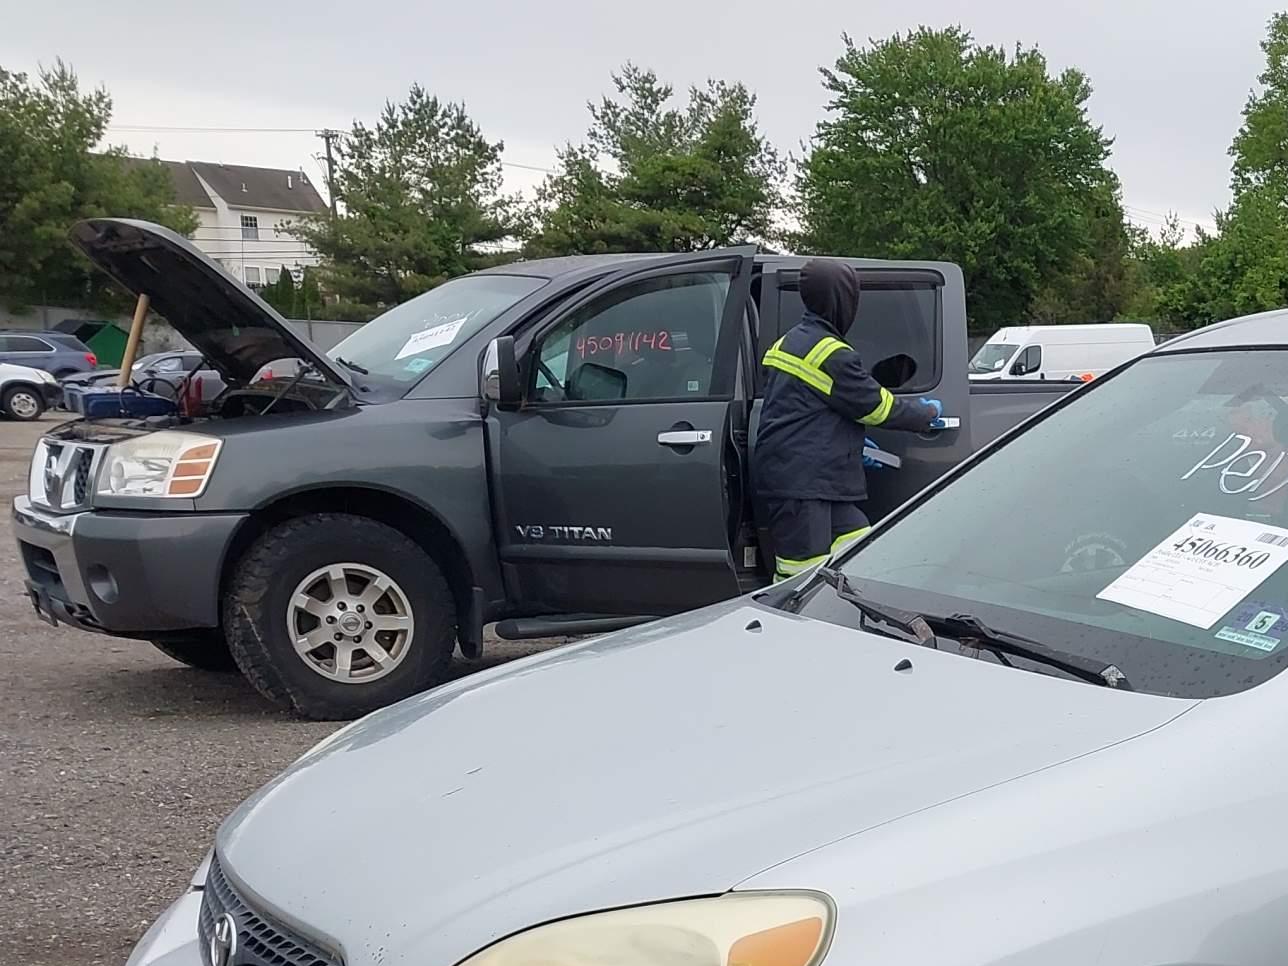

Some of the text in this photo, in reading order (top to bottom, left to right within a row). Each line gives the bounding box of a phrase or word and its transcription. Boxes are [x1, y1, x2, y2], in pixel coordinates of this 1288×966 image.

[576, 331, 672, 359] 45091142
[516, 525, 612, 540] V8 TITAN
[1173, 535, 1271, 570] 45066360
[1254, 615, 1272, 630] 5
